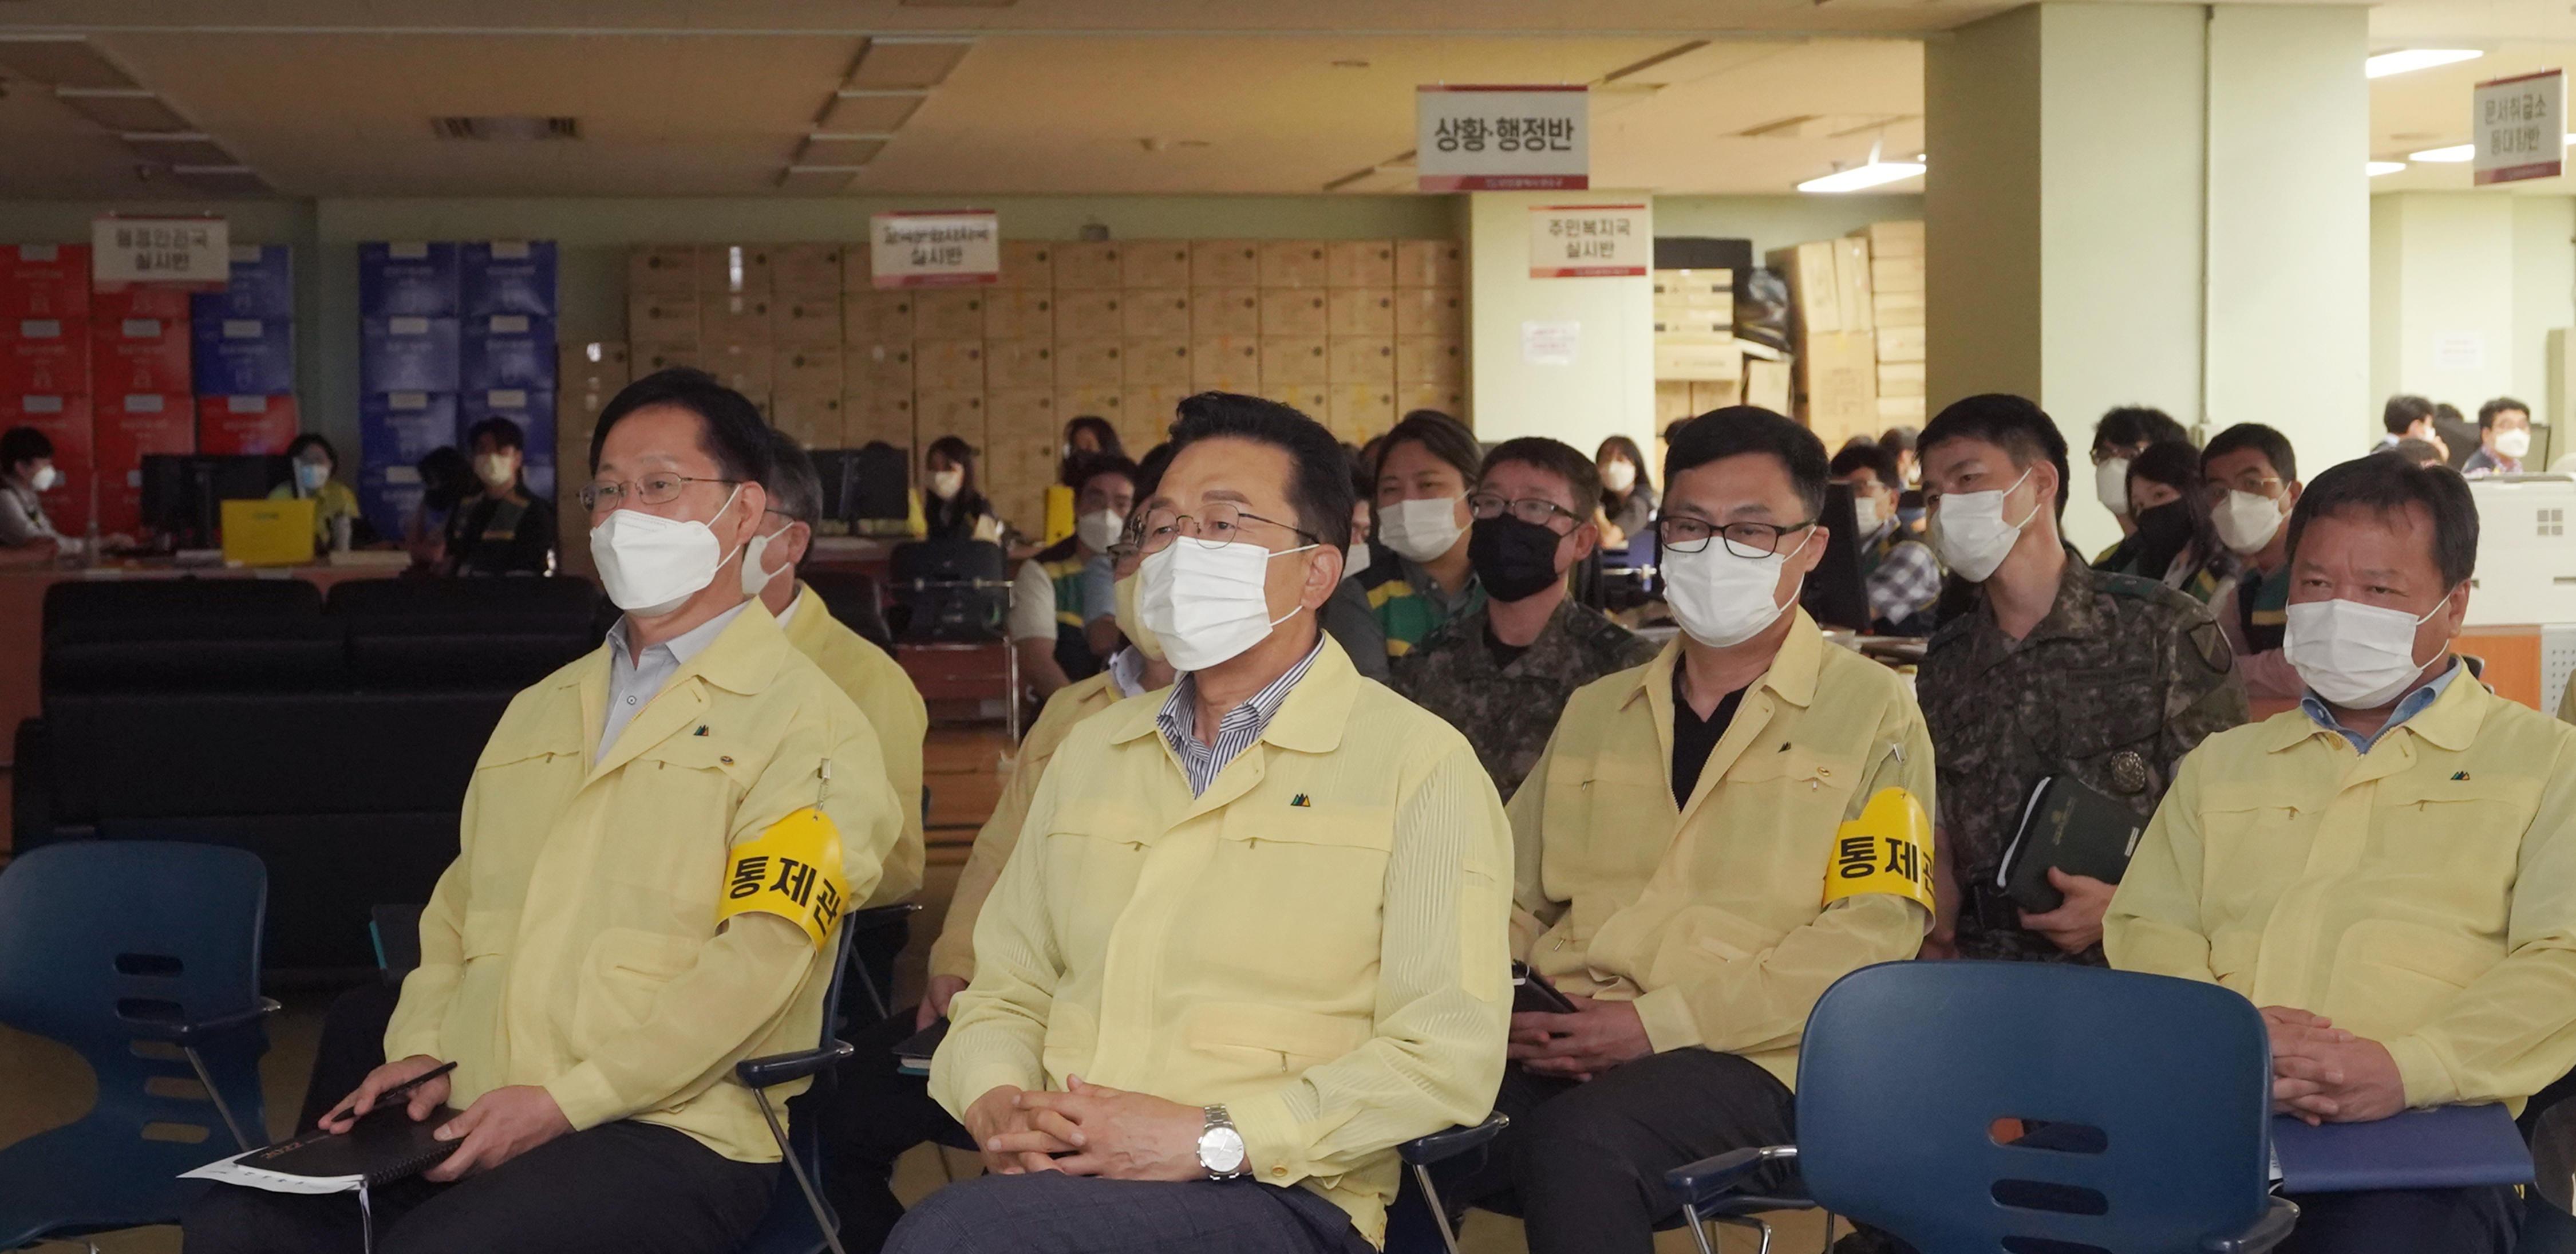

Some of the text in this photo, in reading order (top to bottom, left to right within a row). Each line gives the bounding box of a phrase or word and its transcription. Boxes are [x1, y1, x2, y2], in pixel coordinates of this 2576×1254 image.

[1435, 117, 1574, 151] 상황·행정반
[1549, 219, 1631, 237] 주민복지국
[1567, 240, 1614, 258] 실시반
[730, 856, 840, 938] 통제관
